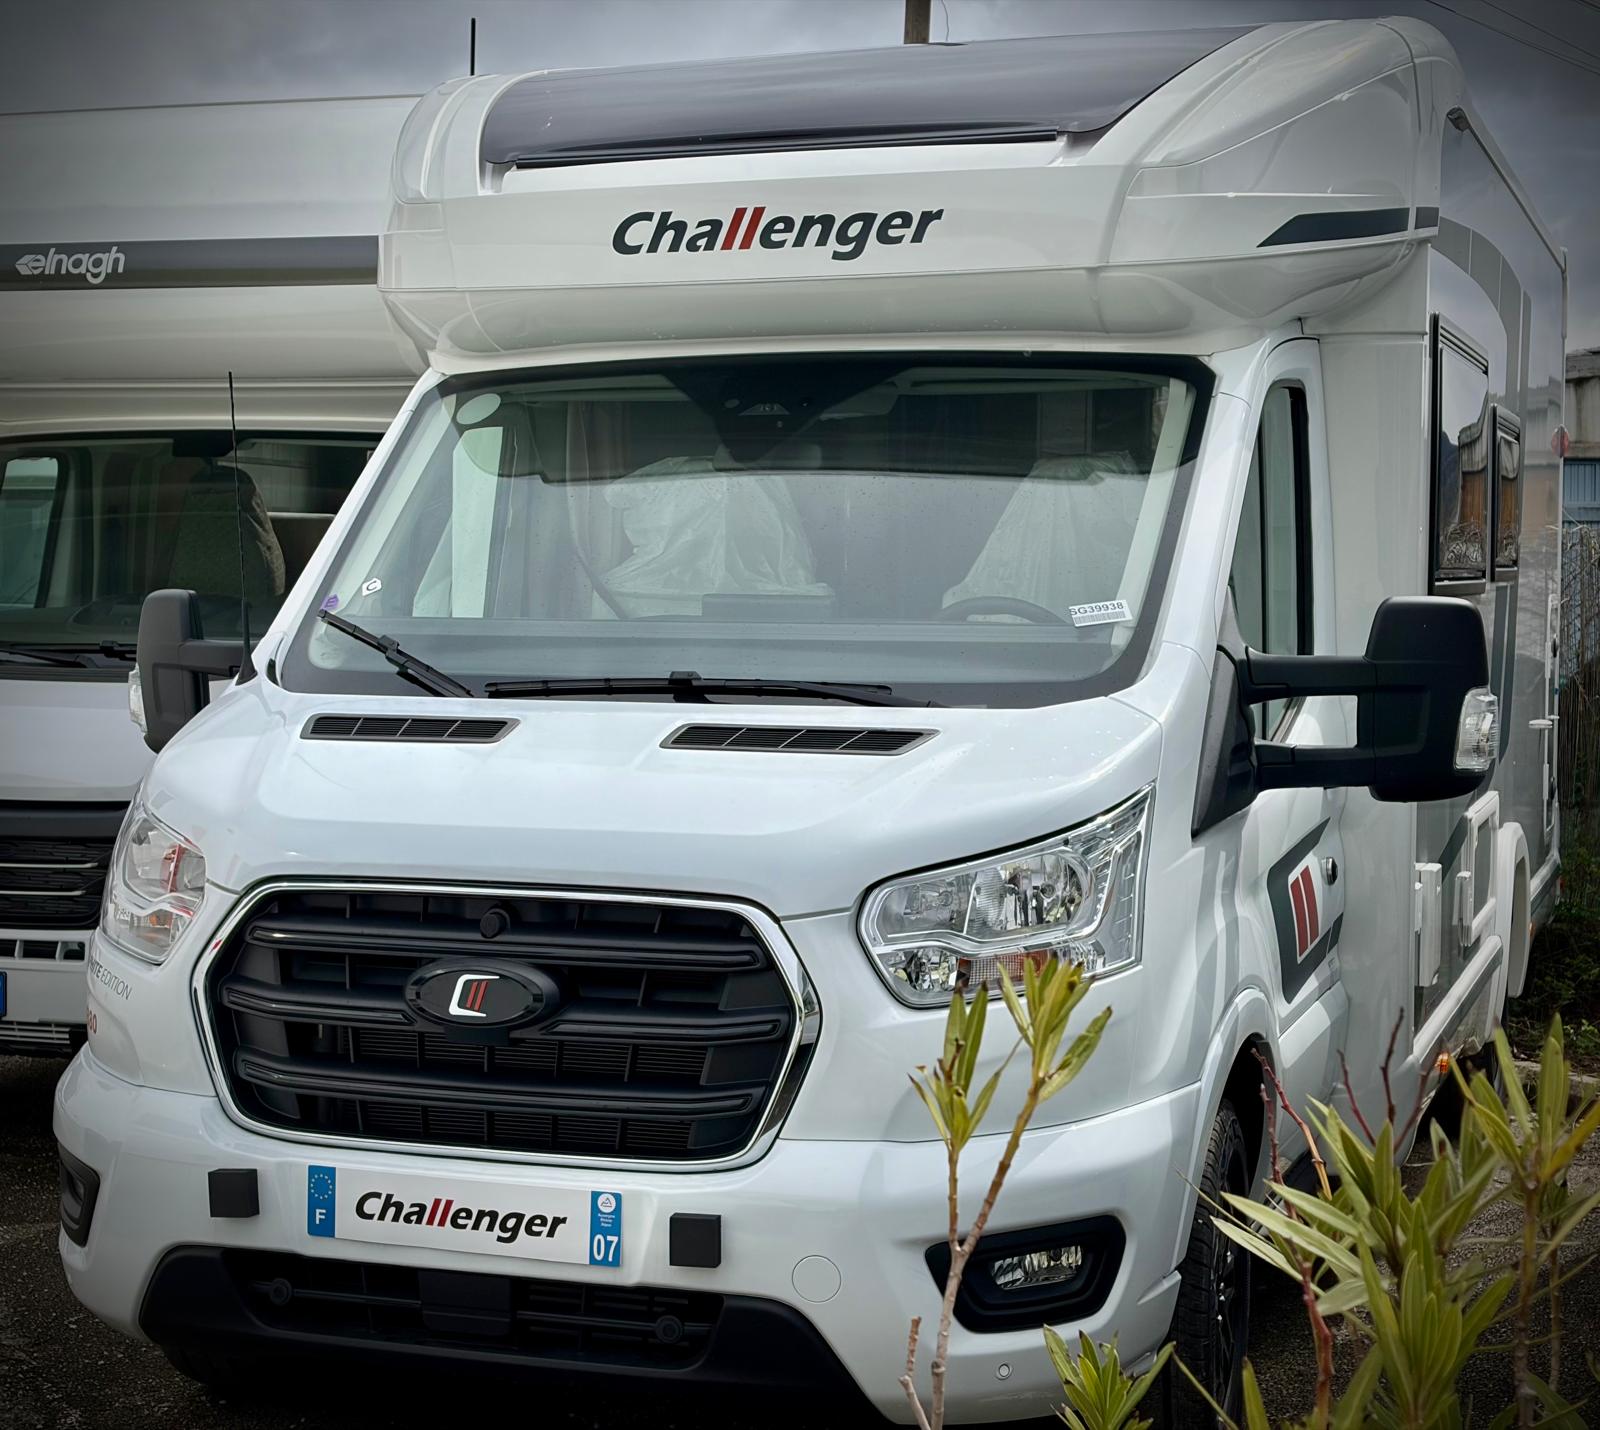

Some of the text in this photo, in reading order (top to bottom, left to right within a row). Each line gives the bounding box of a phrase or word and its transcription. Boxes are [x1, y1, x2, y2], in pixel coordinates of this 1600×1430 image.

[612, 206, 945, 262] Challenger
[30, 246, 126, 284] elnagh
[1069, 602, 1124, 616] SG39938
[100, 969, 133, 1000] EDITION
[315, 1208, 327, 1225] F
[355, 1191, 568, 1244] Challenger
[593, 1233, 619, 1263] 07
